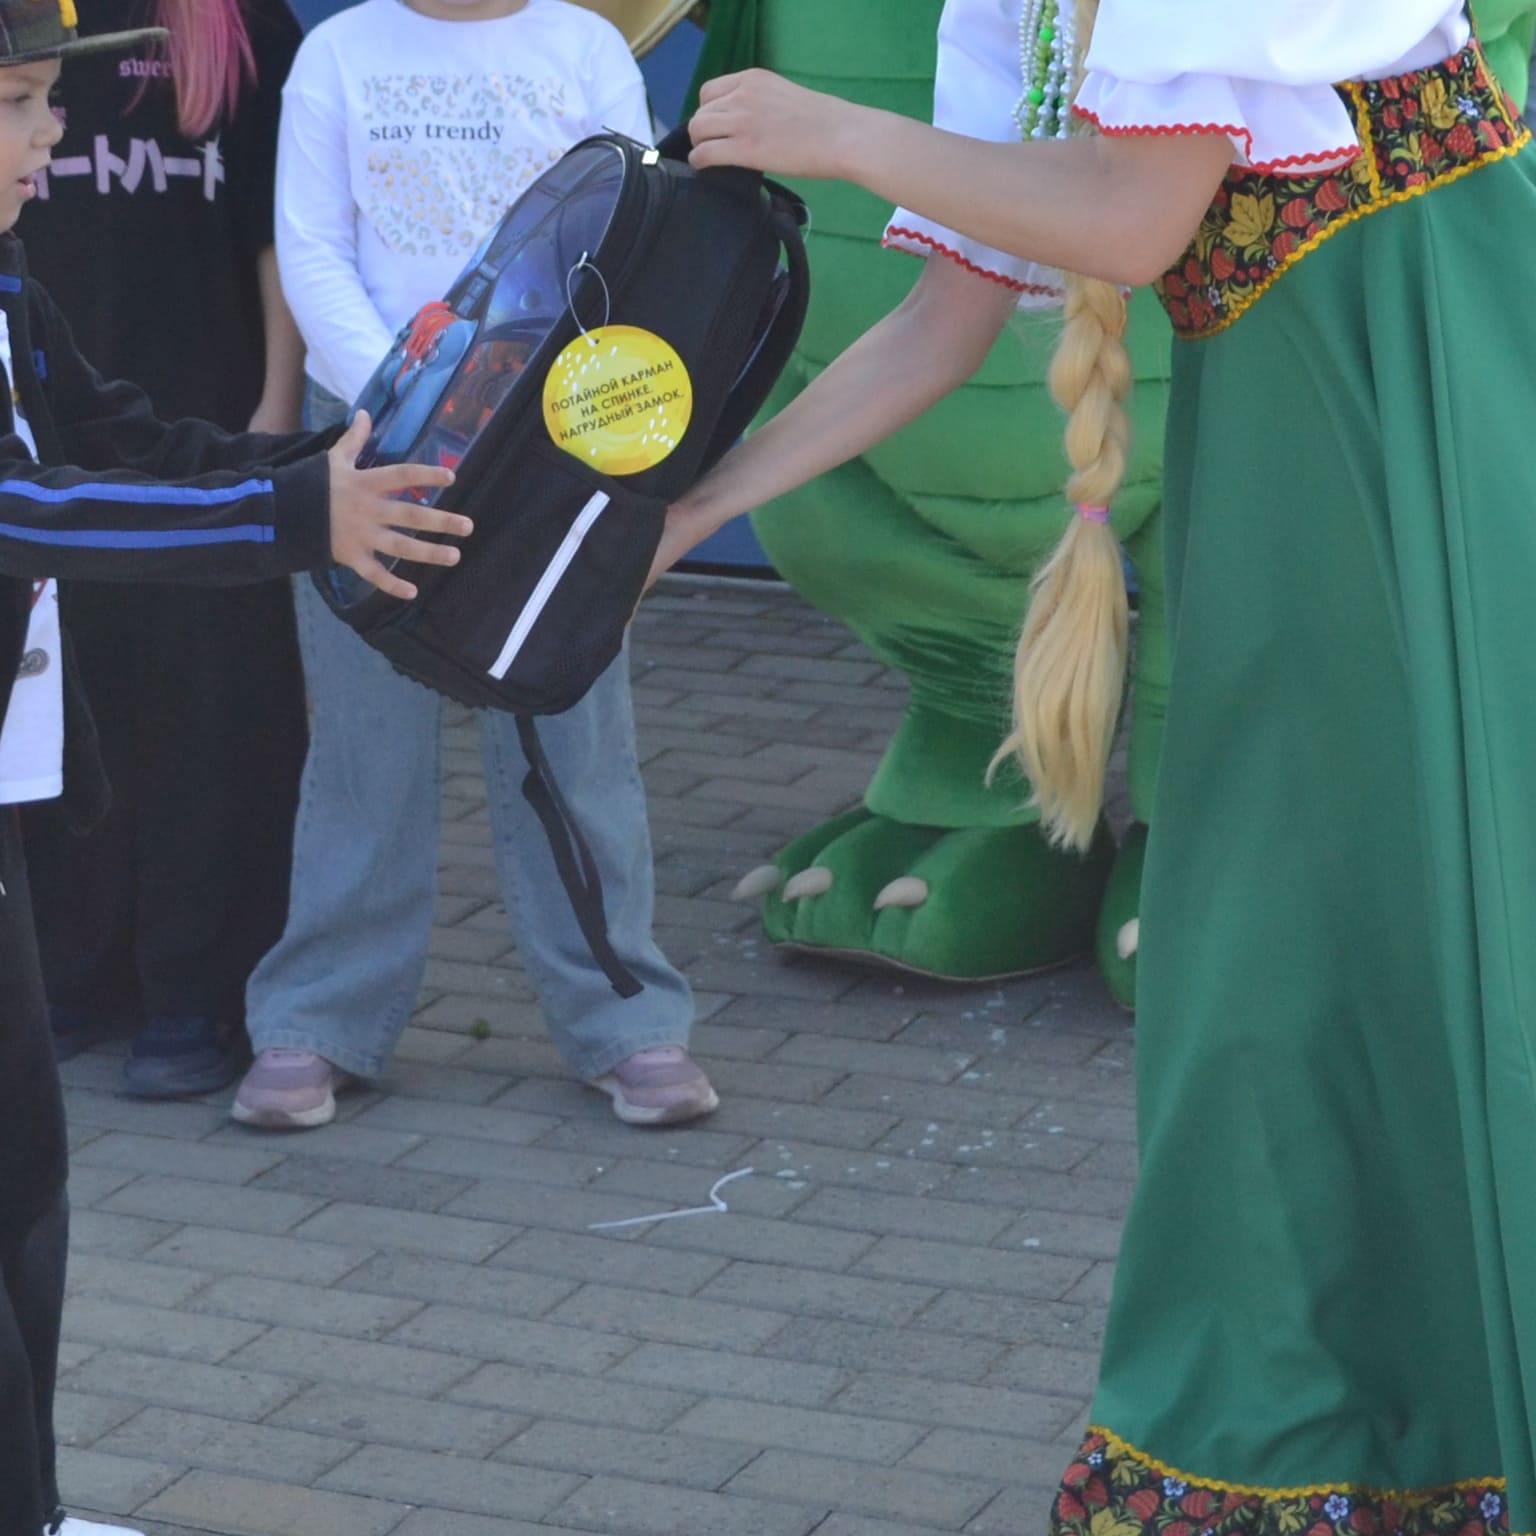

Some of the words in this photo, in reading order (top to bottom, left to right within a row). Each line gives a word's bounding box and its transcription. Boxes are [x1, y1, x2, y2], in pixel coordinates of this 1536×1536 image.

[369, 122, 416, 144] stay
[425, 120, 505, 144] trendy
[551, 378, 619, 413] ПОТАЙНОЙ
[621, 360, 674, 387] КАРМАН
[580, 404, 599, 417] НА
[601, 384, 654, 410] СПИНКЕ.
[559, 405, 634, 441] НАГРУДНЫЙ
[636, 389, 684, 414] ЗАМОК.
